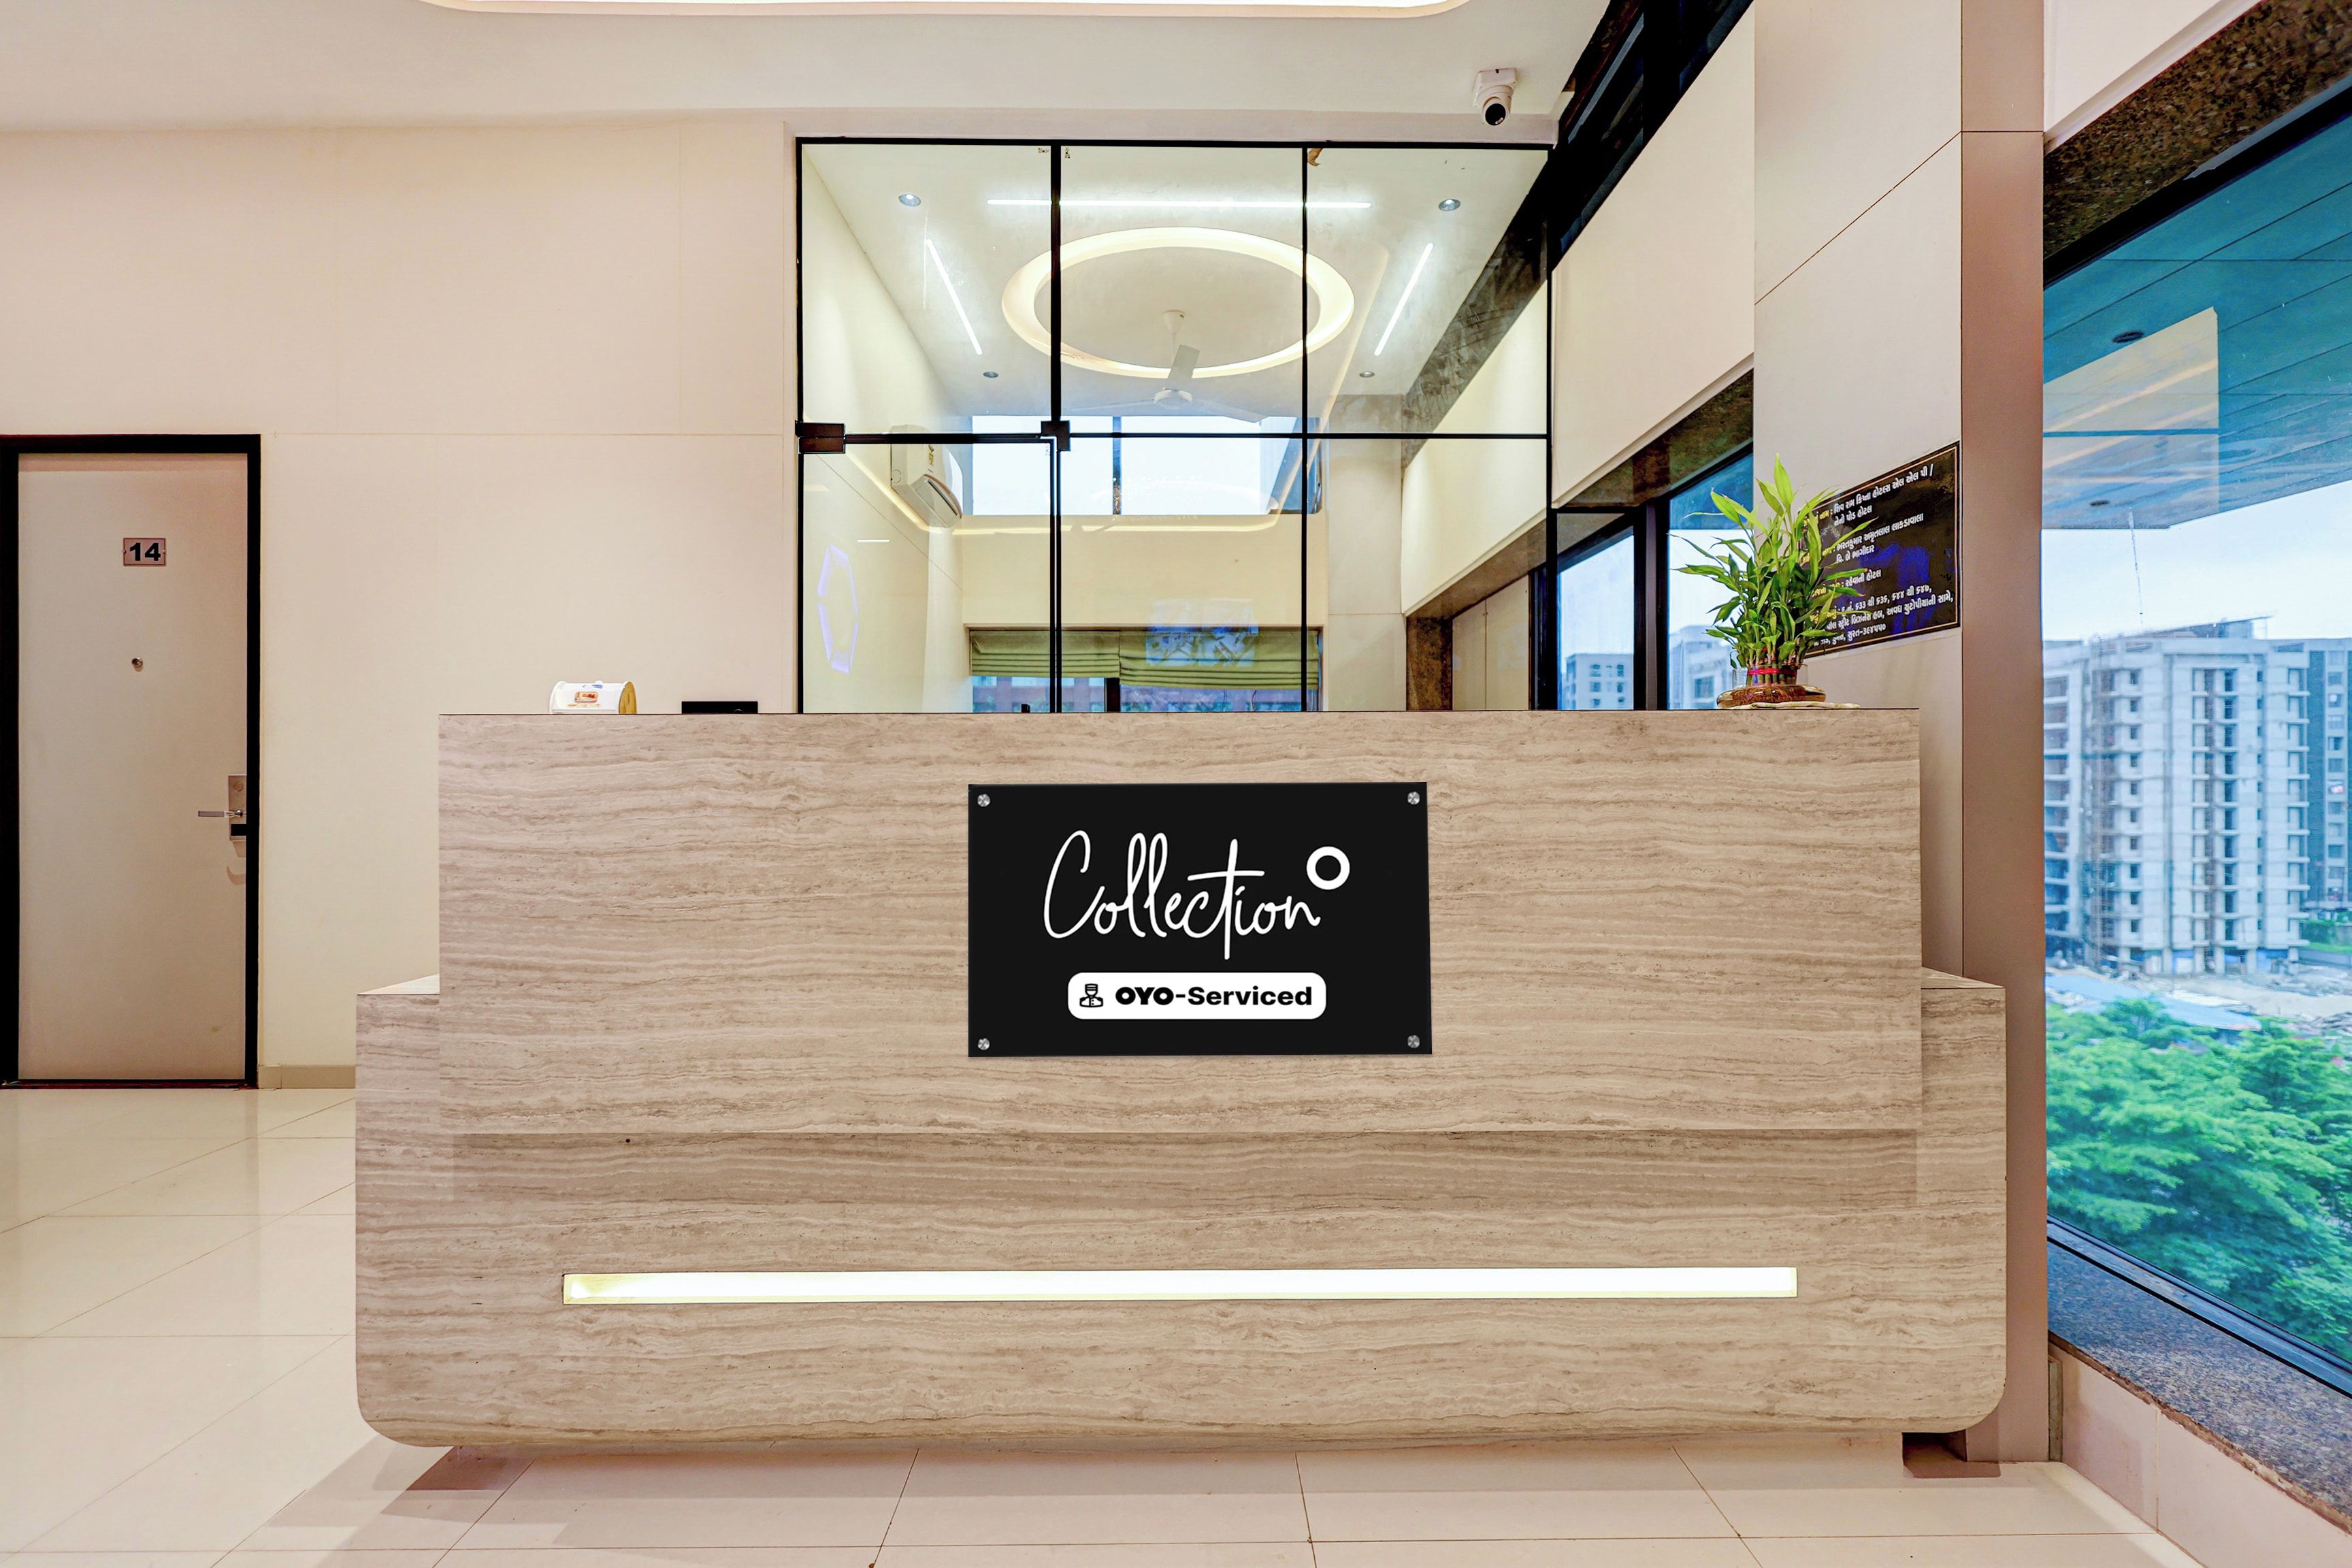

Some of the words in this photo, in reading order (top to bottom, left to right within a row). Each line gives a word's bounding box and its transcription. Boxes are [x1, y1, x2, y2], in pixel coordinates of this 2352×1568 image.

[1845, 499, 1855, 508] રામ
[1892, 477, 1904, 489] એલ
[1906, 471, 1918, 483] એલ
[1846, 510, 1856, 521] પોડ
[1857, 505, 1872, 518] હોટલ
[1863, 525, 1890, 542] અમૃતલાલ
[1891, 513, 1924, 531] લાકડાવાલા
[129, 542, 161, 561] 14
[1866, 570, 1882, 581] હોટલ
[1886, 605, 1902, 615] અવધ
[1043, 830, 1321, 960] Collection
[1115, 985, 1312, 1007] OYO-Serviced
